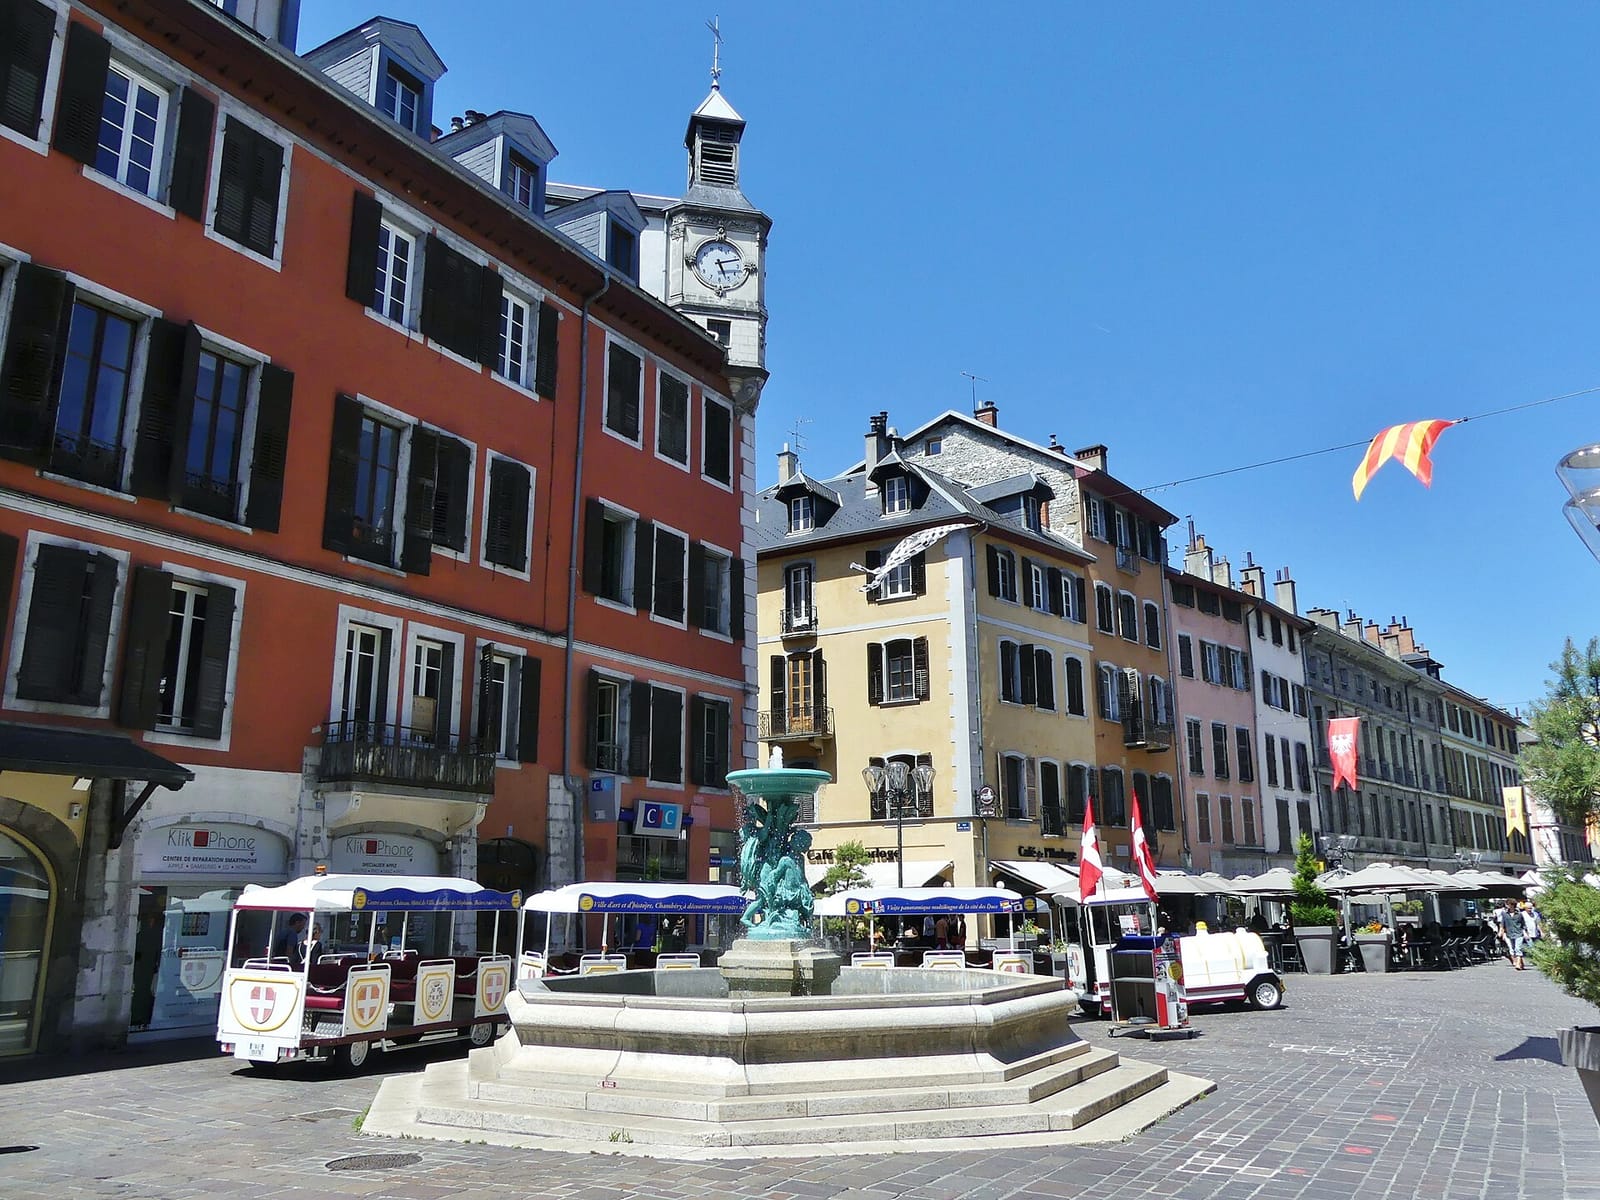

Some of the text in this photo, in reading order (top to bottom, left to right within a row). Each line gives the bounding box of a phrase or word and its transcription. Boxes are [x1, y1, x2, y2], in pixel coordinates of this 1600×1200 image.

[647, 808, 675, 825] CIC
[167, 829, 256, 849] Klik Phone
[346, 839, 414, 856] Klik Phone
[807, 849, 834, 861] Café
